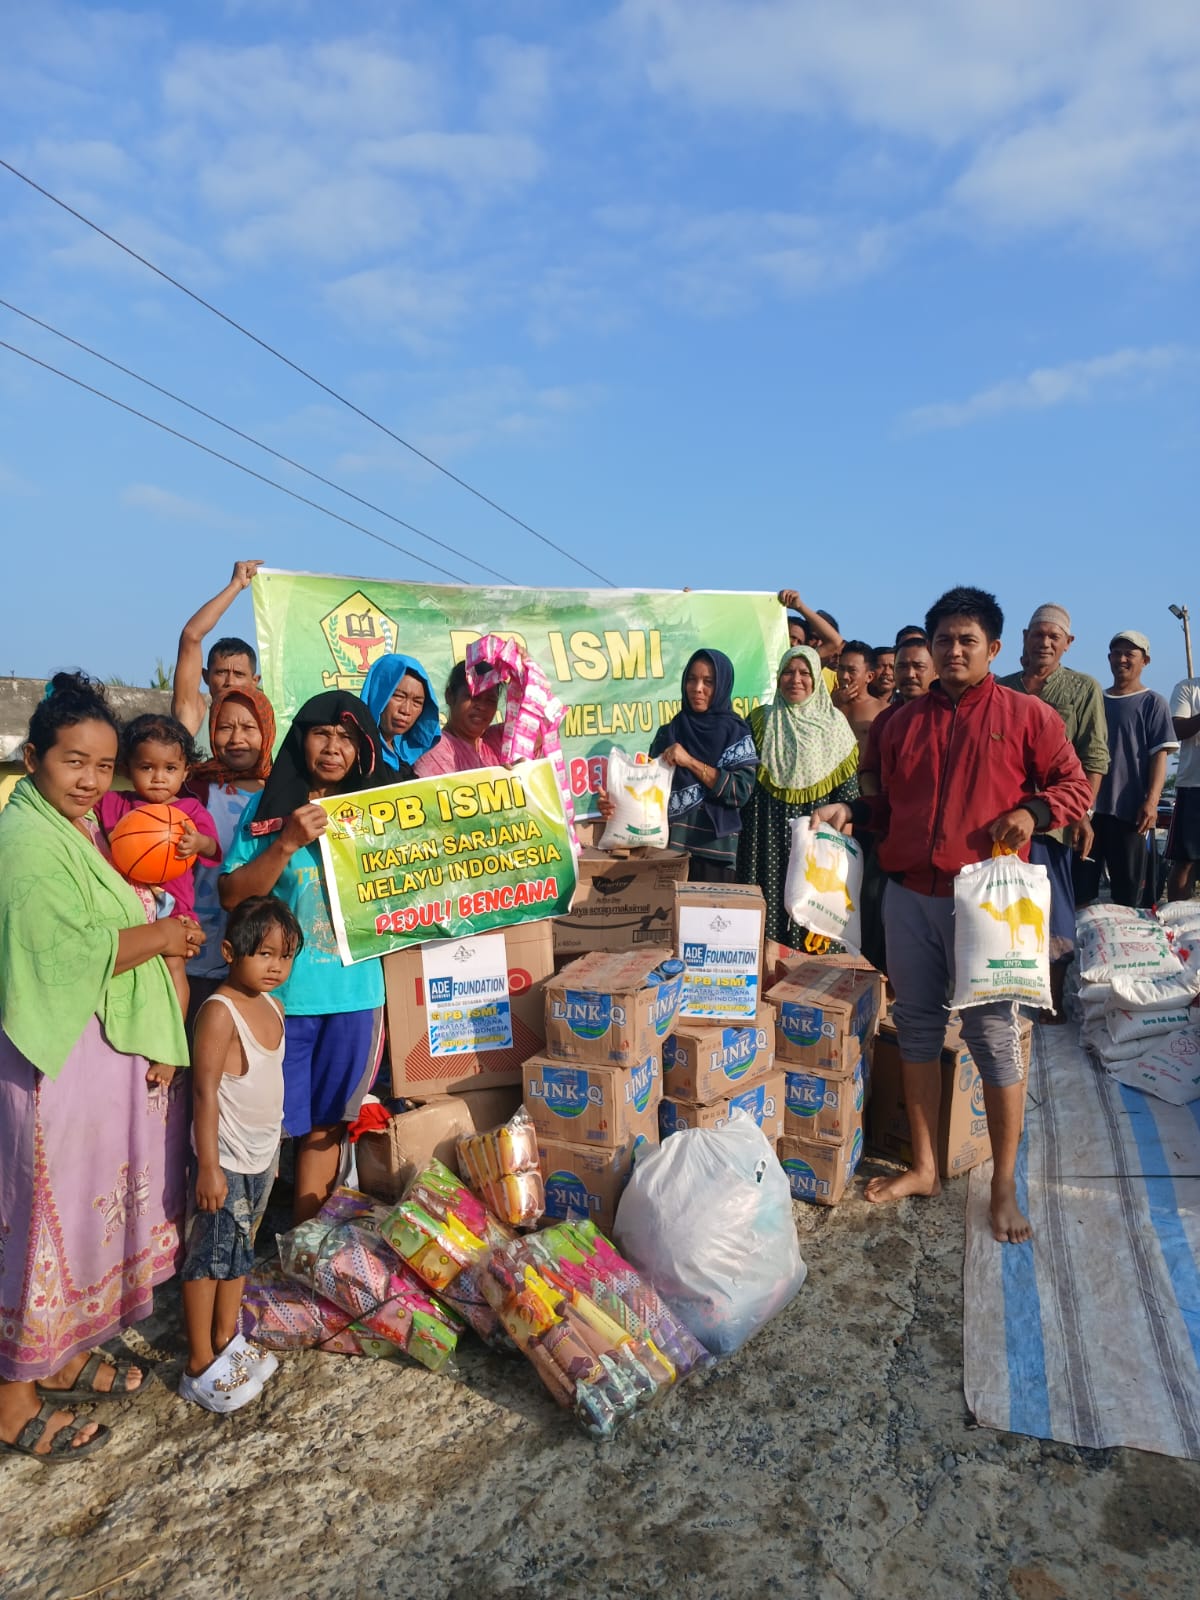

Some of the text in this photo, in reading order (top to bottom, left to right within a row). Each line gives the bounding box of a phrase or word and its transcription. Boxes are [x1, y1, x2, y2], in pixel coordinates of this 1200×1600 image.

[548, 629, 664, 682] ISMI
[565, 701, 653, 738] MELAYU
[368, 776, 527, 836] PB ISMI
[361, 820, 543, 874] IKATAN SARJANA
[357, 844, 562, 904] MELAYU INDONESIA
[375, 876, 559, 936] PEDULI BENCANA
[685, 947, 703, 959] ADE
[706, 949, 756, 965] FOUNDATION
[431, 980, 450, 994] ADE
[453, 977, 505, 996] FOUNDATION
[694, 976, 746, 987] PB ISMI
[444, 1005, 498, 1021] PB ISMI
[552, 1001, 627, 1027] LINK-Q
[775, 1014, 837, 1040] INK-Q
[709, 1029, 768, 1073] LINK-Q
[529, 1079, 604, 1106] LINK-Q
[625, 1055, 659, 1105] LINK-Q
